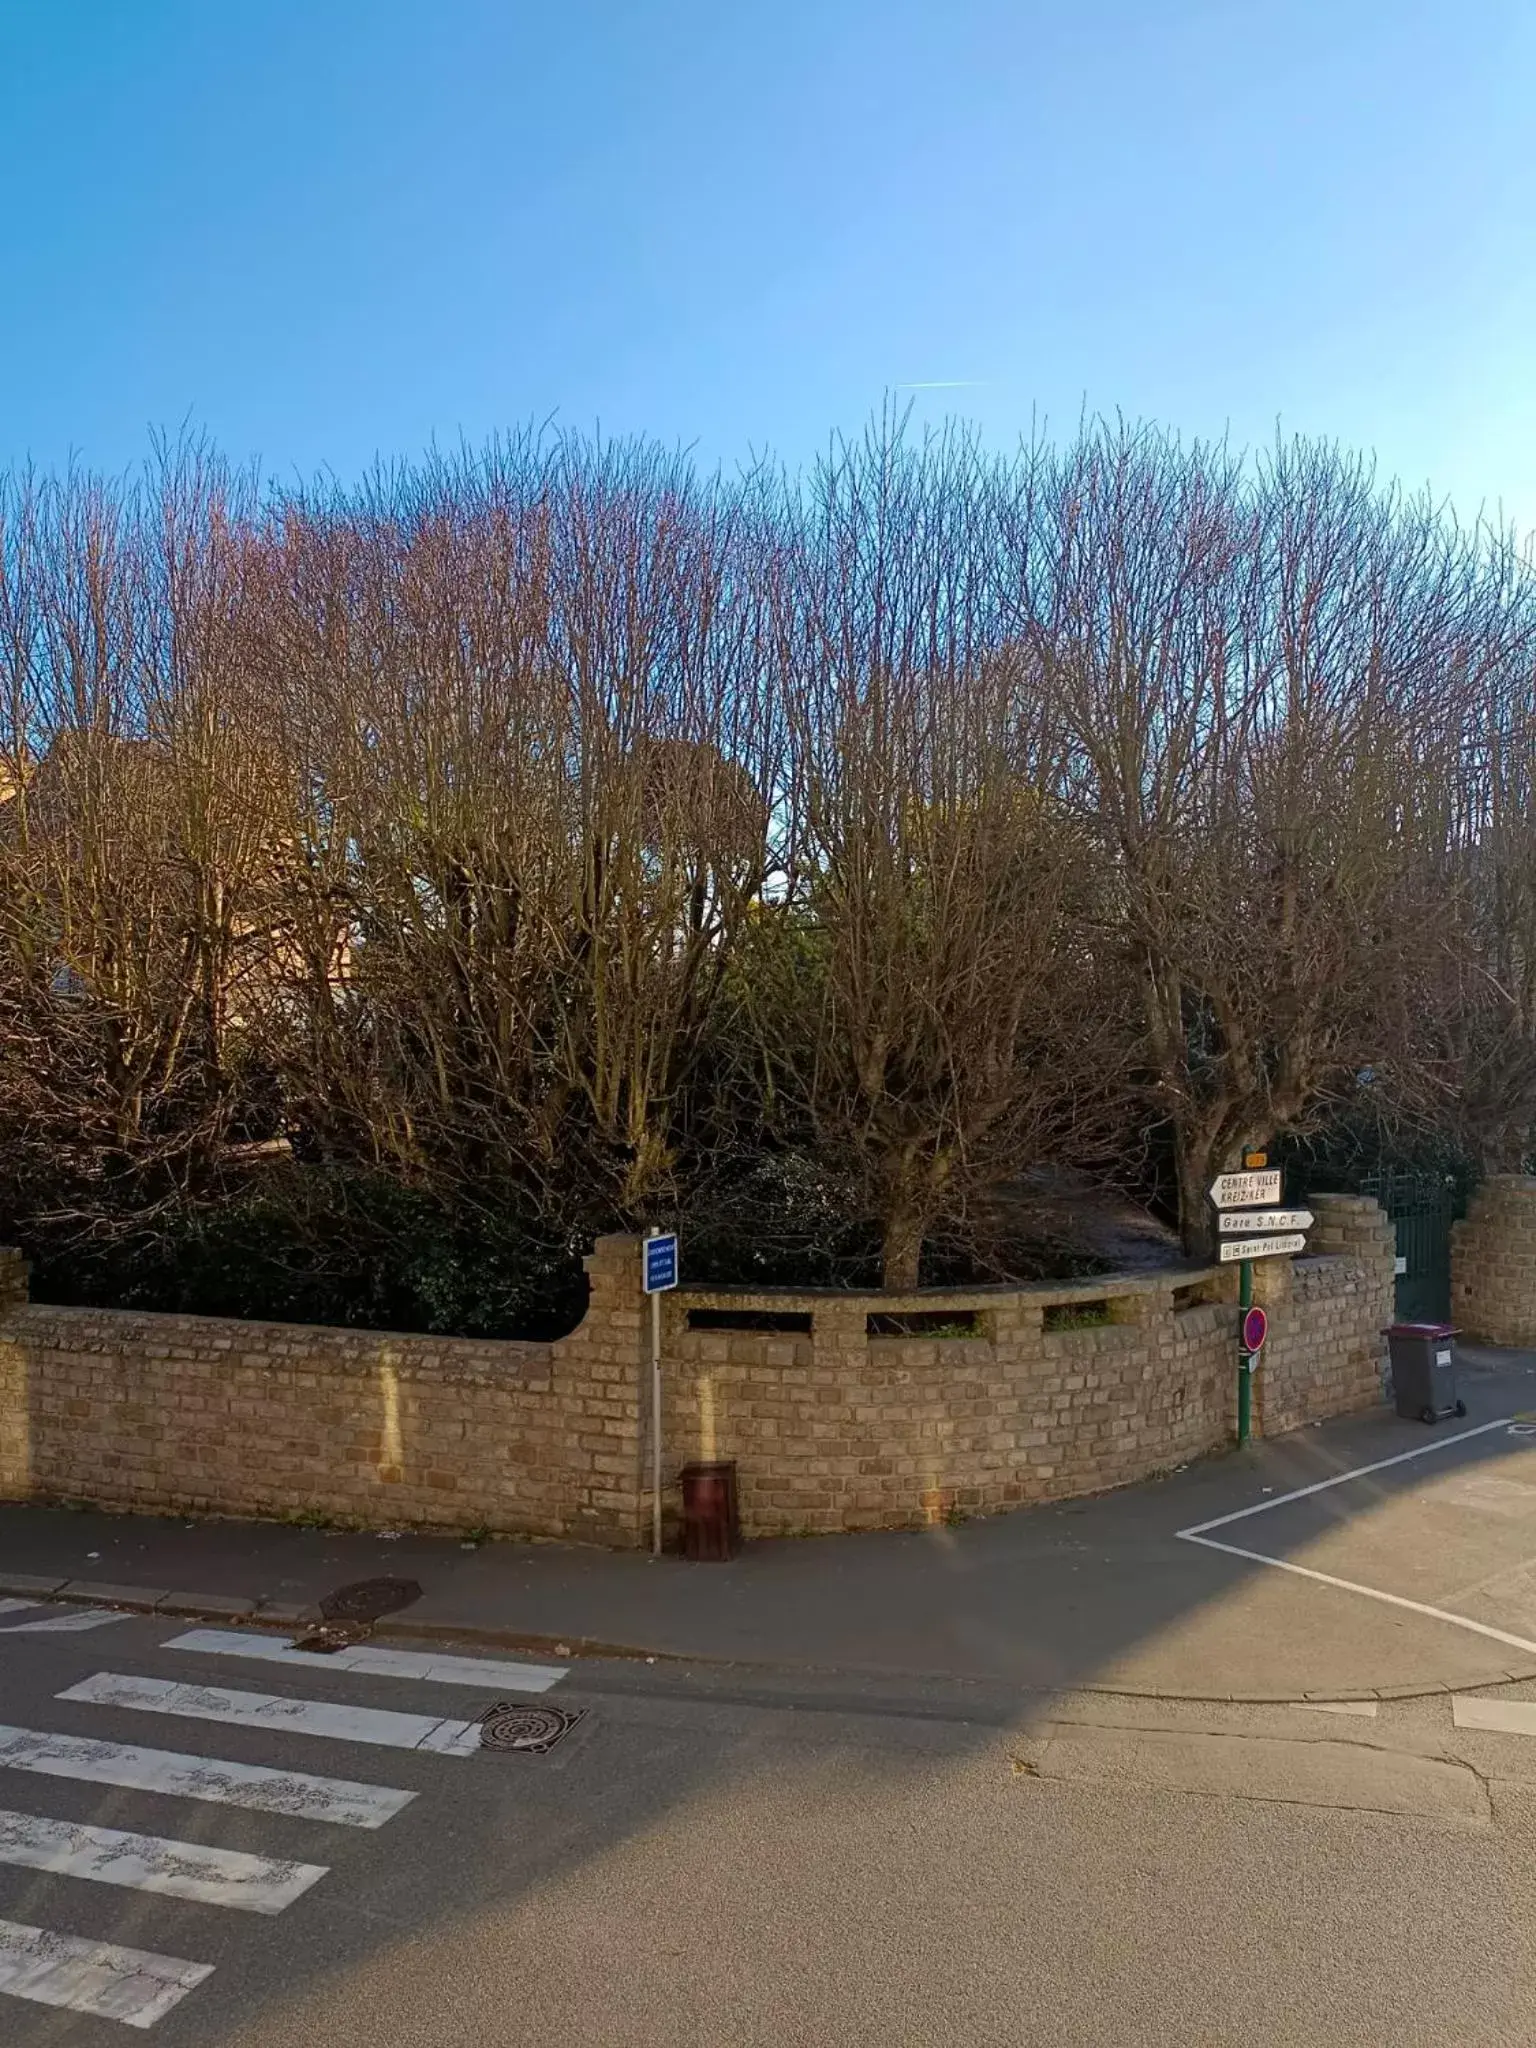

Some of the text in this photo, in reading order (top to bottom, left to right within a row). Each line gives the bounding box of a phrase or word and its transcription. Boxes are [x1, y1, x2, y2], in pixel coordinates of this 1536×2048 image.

[1222, 1174, 1279, 1189] CENTRE VILLE
[1223, 1214, 1300, 1228] Gare S.N.C.F.
[1241, 1244, 1260, 1255] Saint
